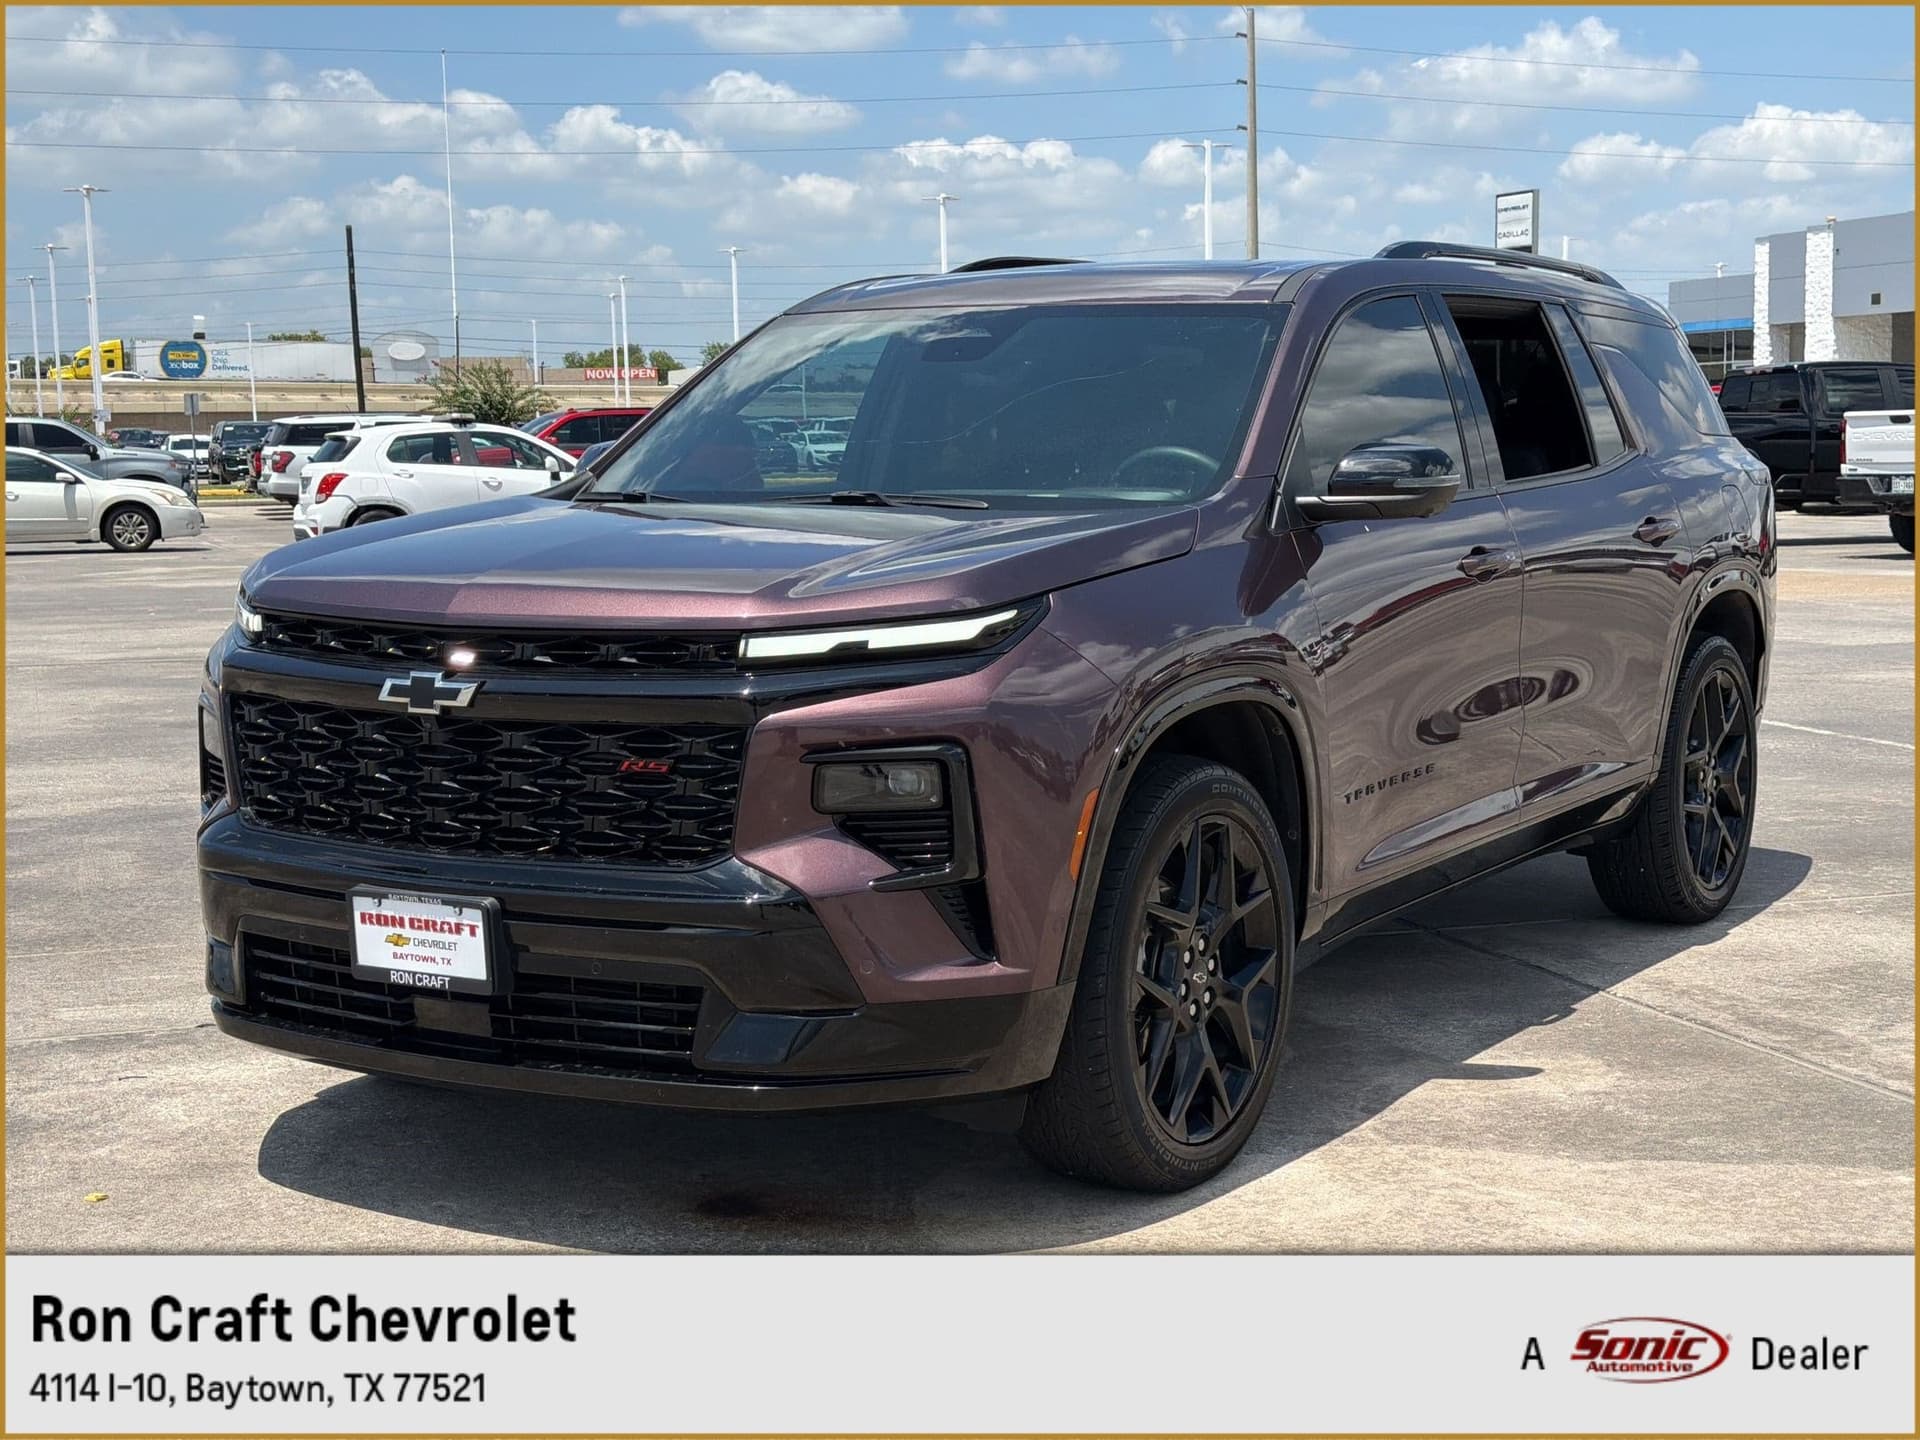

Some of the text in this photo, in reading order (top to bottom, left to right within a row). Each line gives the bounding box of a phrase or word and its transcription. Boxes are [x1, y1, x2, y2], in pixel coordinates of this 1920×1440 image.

[1497, 229, 1529, 239] CADILLAC
[586, 369, 616, 379] NOW
[619, 760, 669, 773] RS
[1344, 763, 1435, 804] TRAVERSE
[360, 912, 480, 938] RON CRAFT
[413, 937, 458, 952] CHEVROLET
[392, 951, 452, 966] BAYTOWN, TX
[390, 970, 451, 989] RON CRAFT
